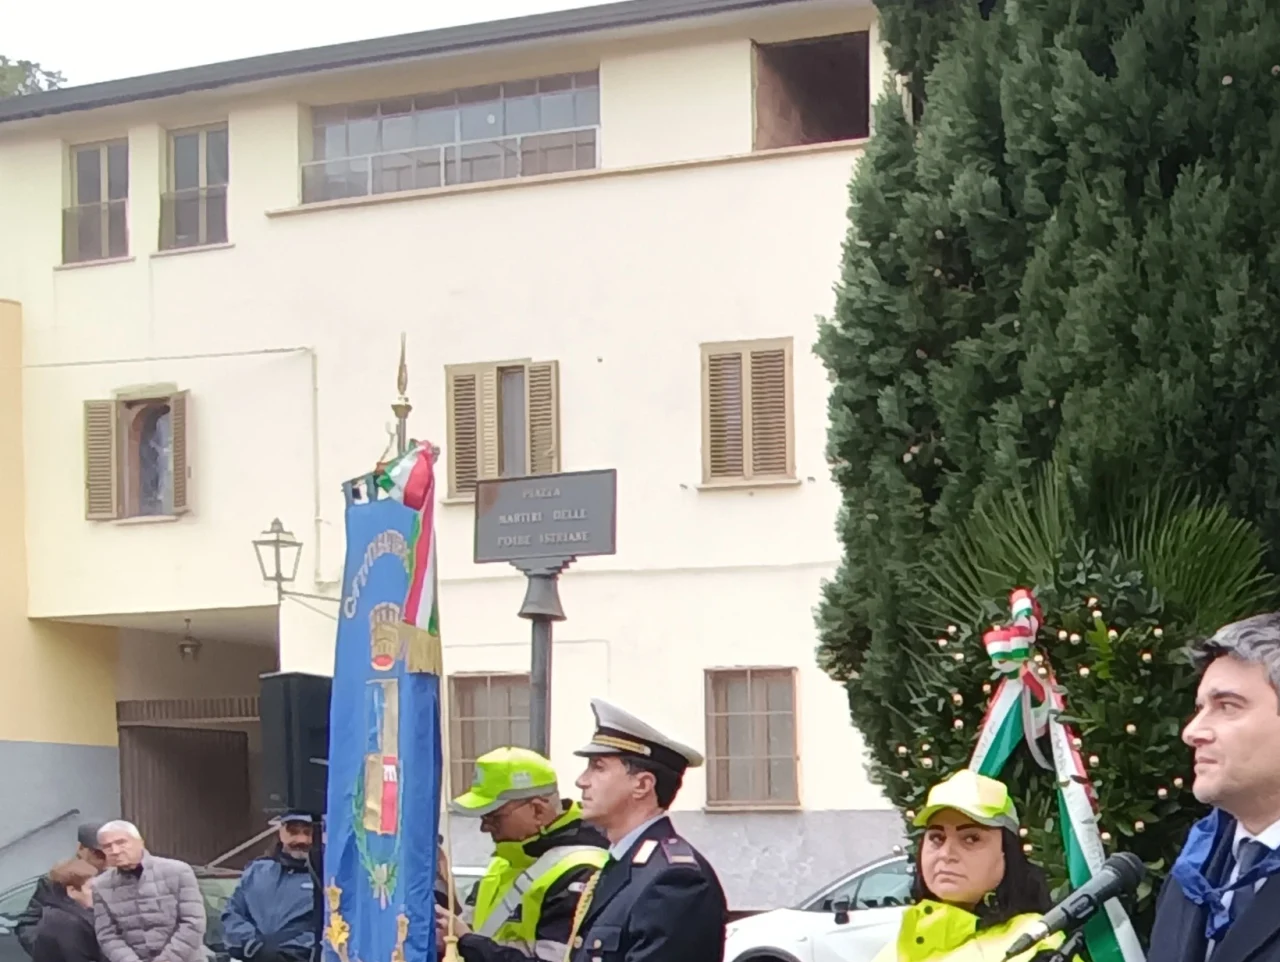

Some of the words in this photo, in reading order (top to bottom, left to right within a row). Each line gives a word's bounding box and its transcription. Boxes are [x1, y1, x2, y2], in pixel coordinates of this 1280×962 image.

[522, 487, 561, 499] PIAZZA
[499, 511, 543, 524] MARTIRI
[552, 508, 588, 520] DELLE
[497, 534, 533, 547] FOIBE
[540, 530, 590, 545] ISTRIANE
